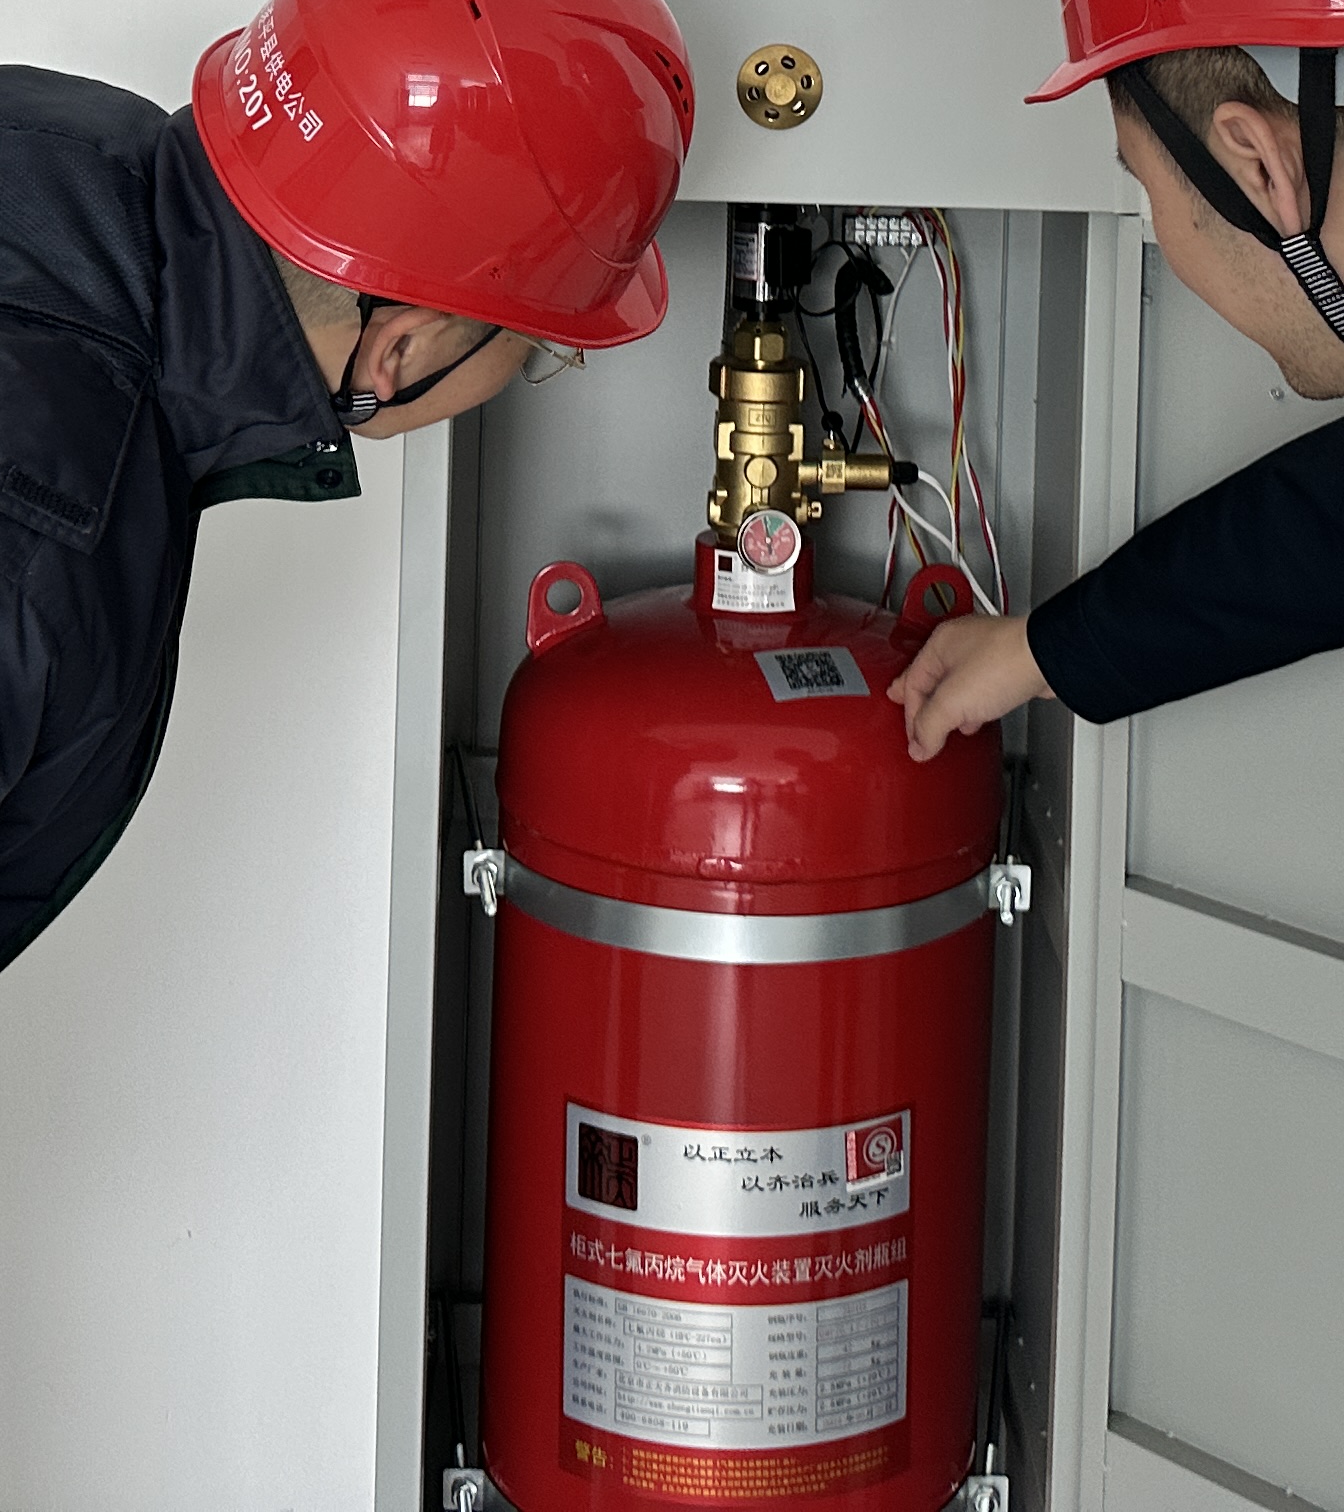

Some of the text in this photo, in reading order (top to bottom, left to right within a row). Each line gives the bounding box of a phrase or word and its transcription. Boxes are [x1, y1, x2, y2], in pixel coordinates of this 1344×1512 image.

[683, 1144, 784, 1164] 以正立本
[799, 1187, 890, 1218] 服务天下
